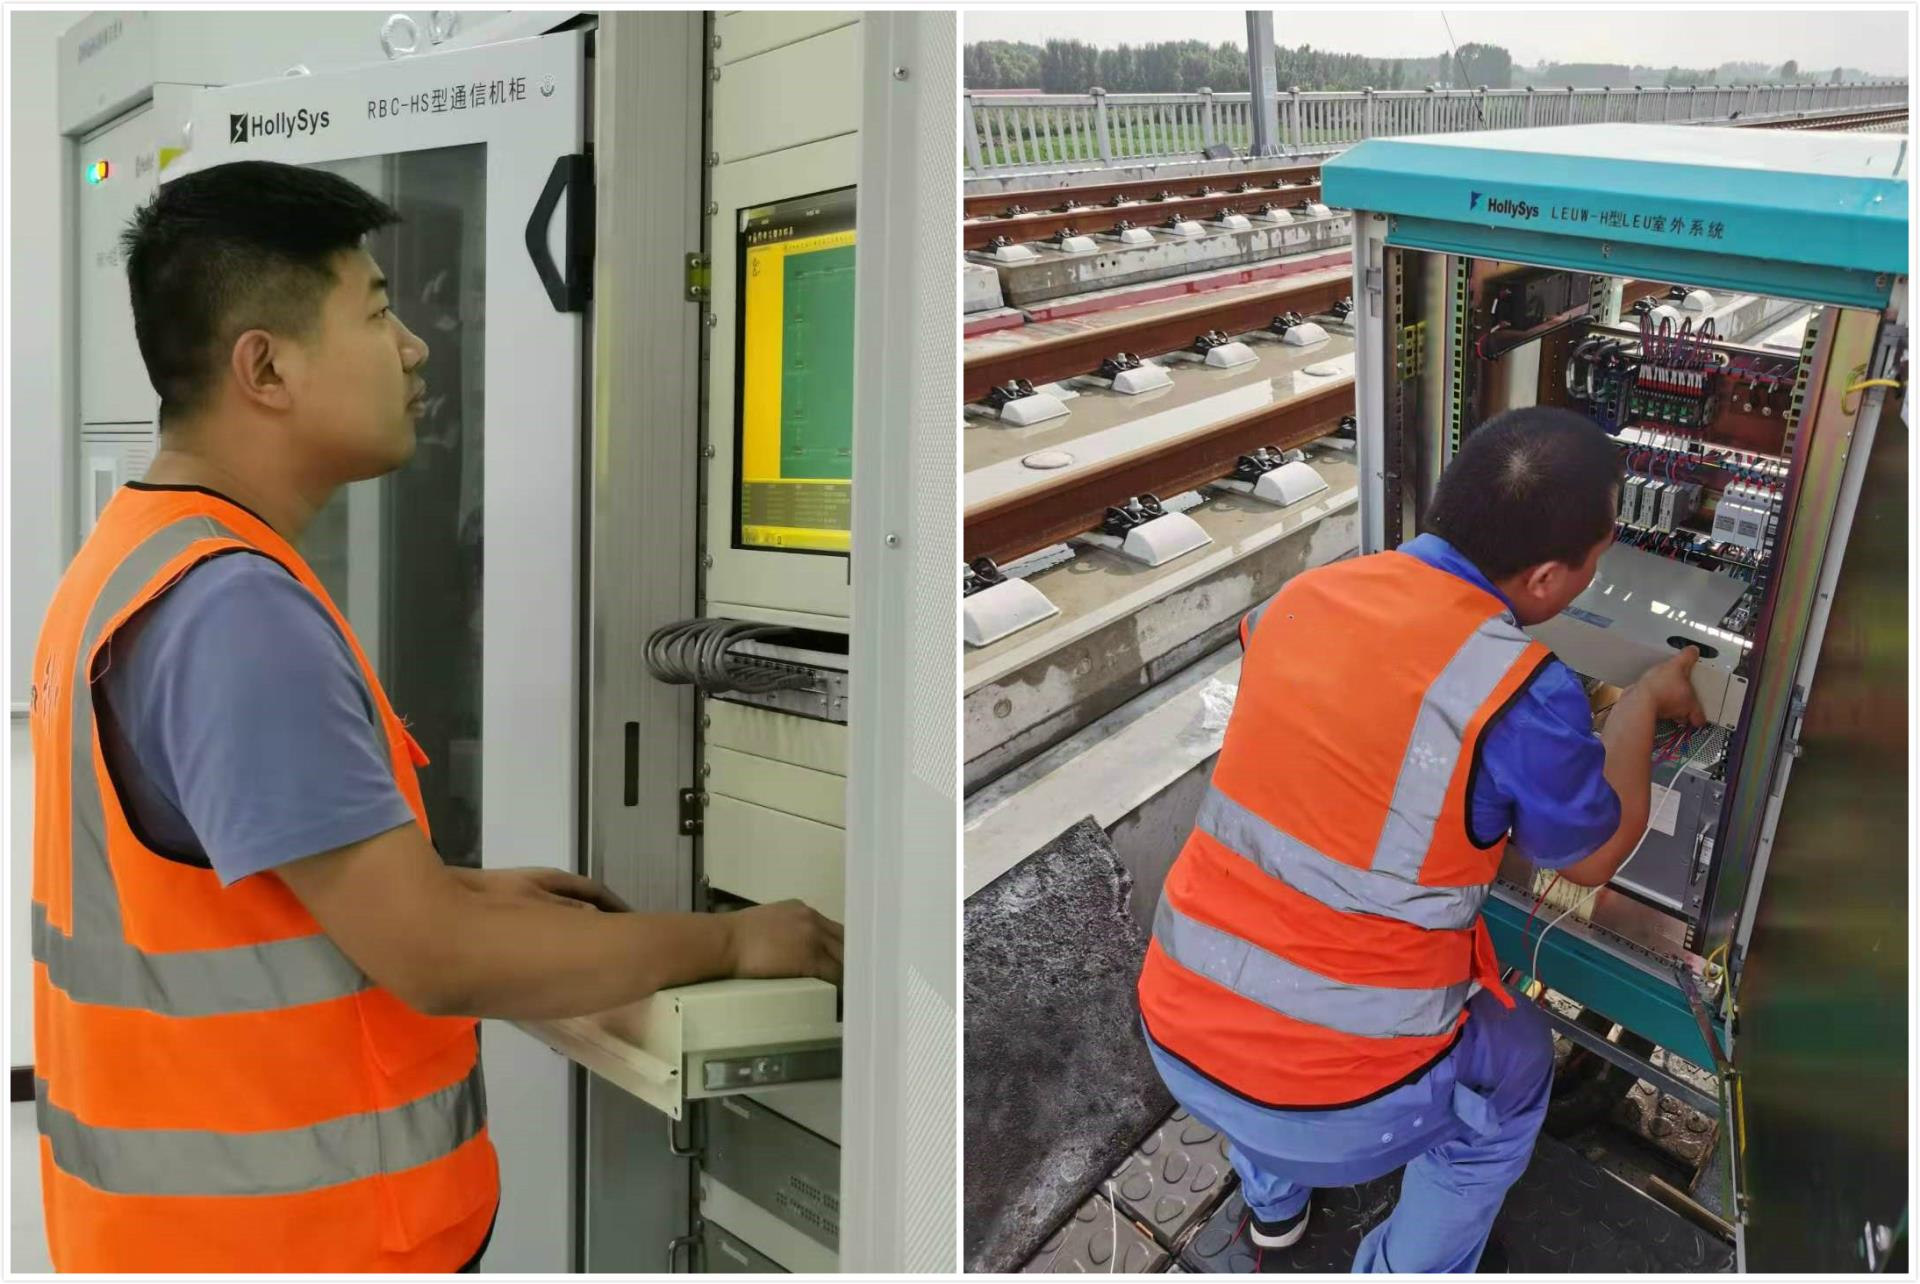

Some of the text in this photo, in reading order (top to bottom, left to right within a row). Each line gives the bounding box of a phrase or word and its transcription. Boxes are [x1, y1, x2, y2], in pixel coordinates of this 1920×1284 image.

[367, 77, 527, 119] RBC-HS型通信机柜
[252, 109, 330, 138] HollySys
[1488, 198, 1540, 220] HollySys
[1551, 207, 1725, 240] LEUW-H型LEU室外系统
